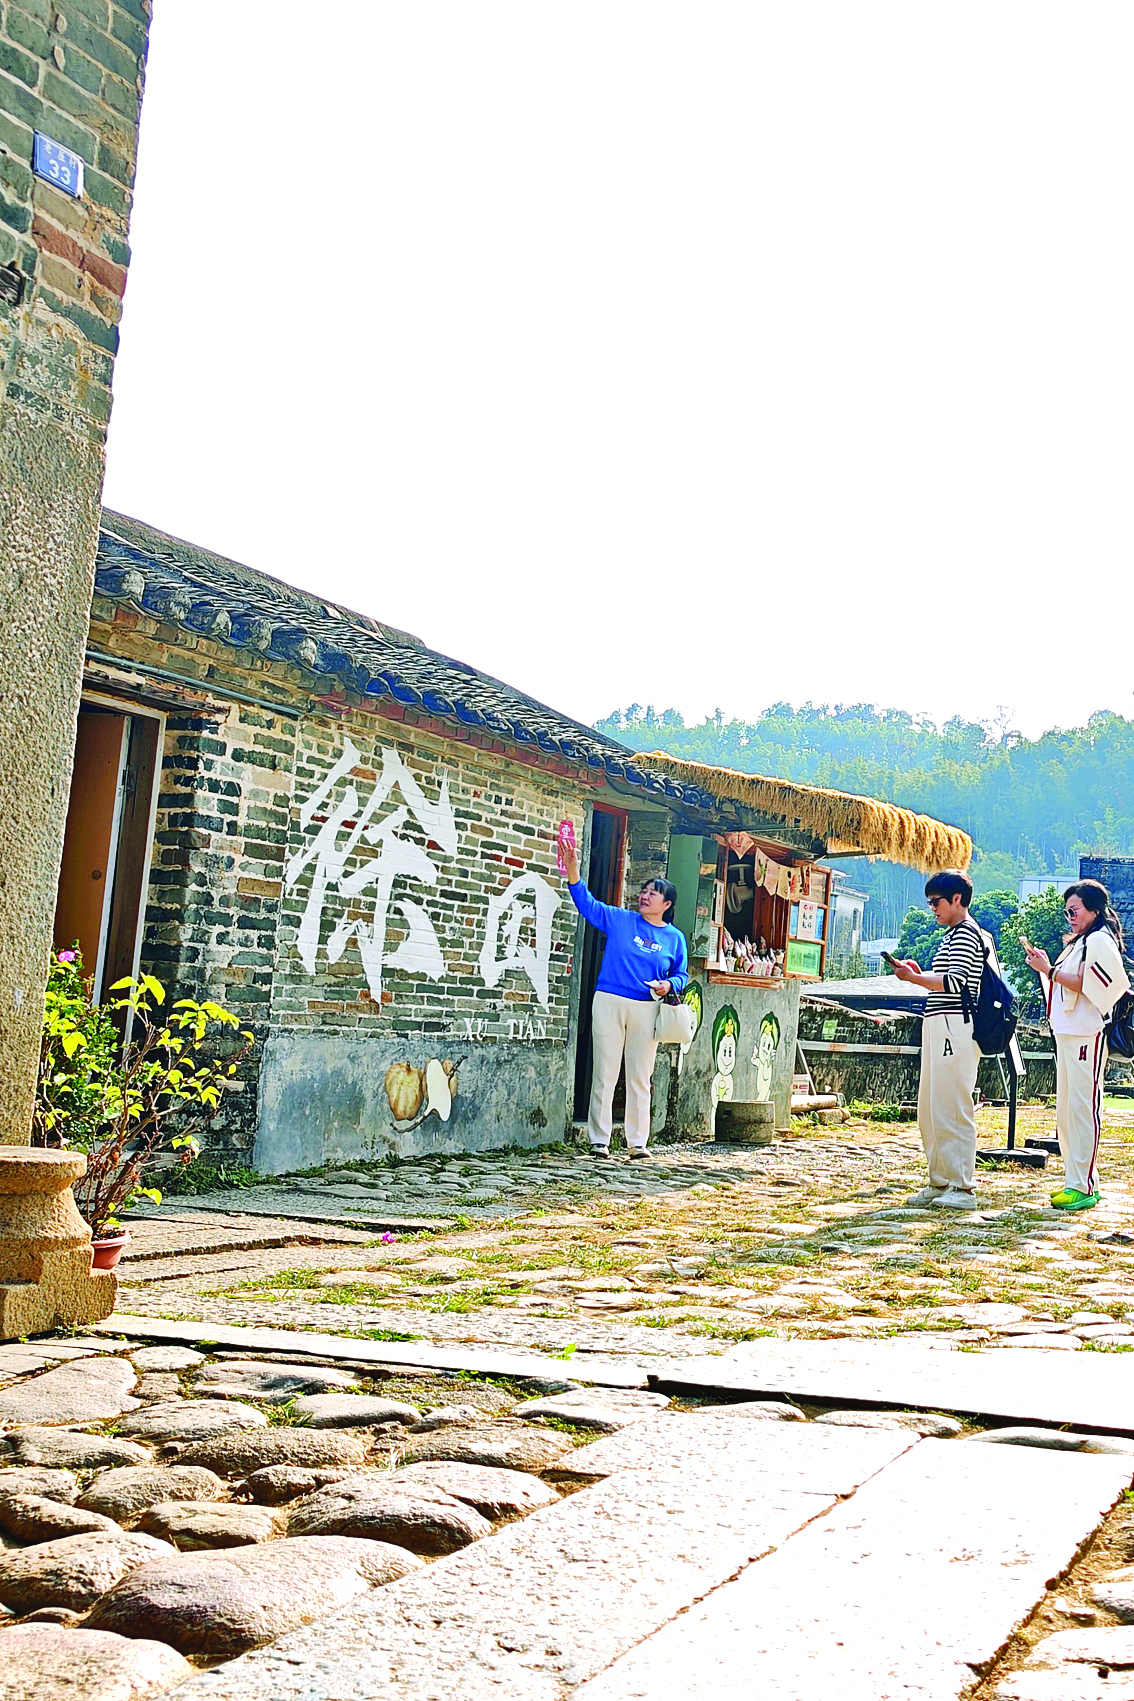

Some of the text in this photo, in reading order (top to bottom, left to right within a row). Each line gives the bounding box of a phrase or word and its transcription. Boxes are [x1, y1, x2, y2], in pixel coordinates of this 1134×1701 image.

[49, 159, 71, 185] 33
[462, 1017, 490, 1041] XU
[942, 1037, 954, 1057] A
